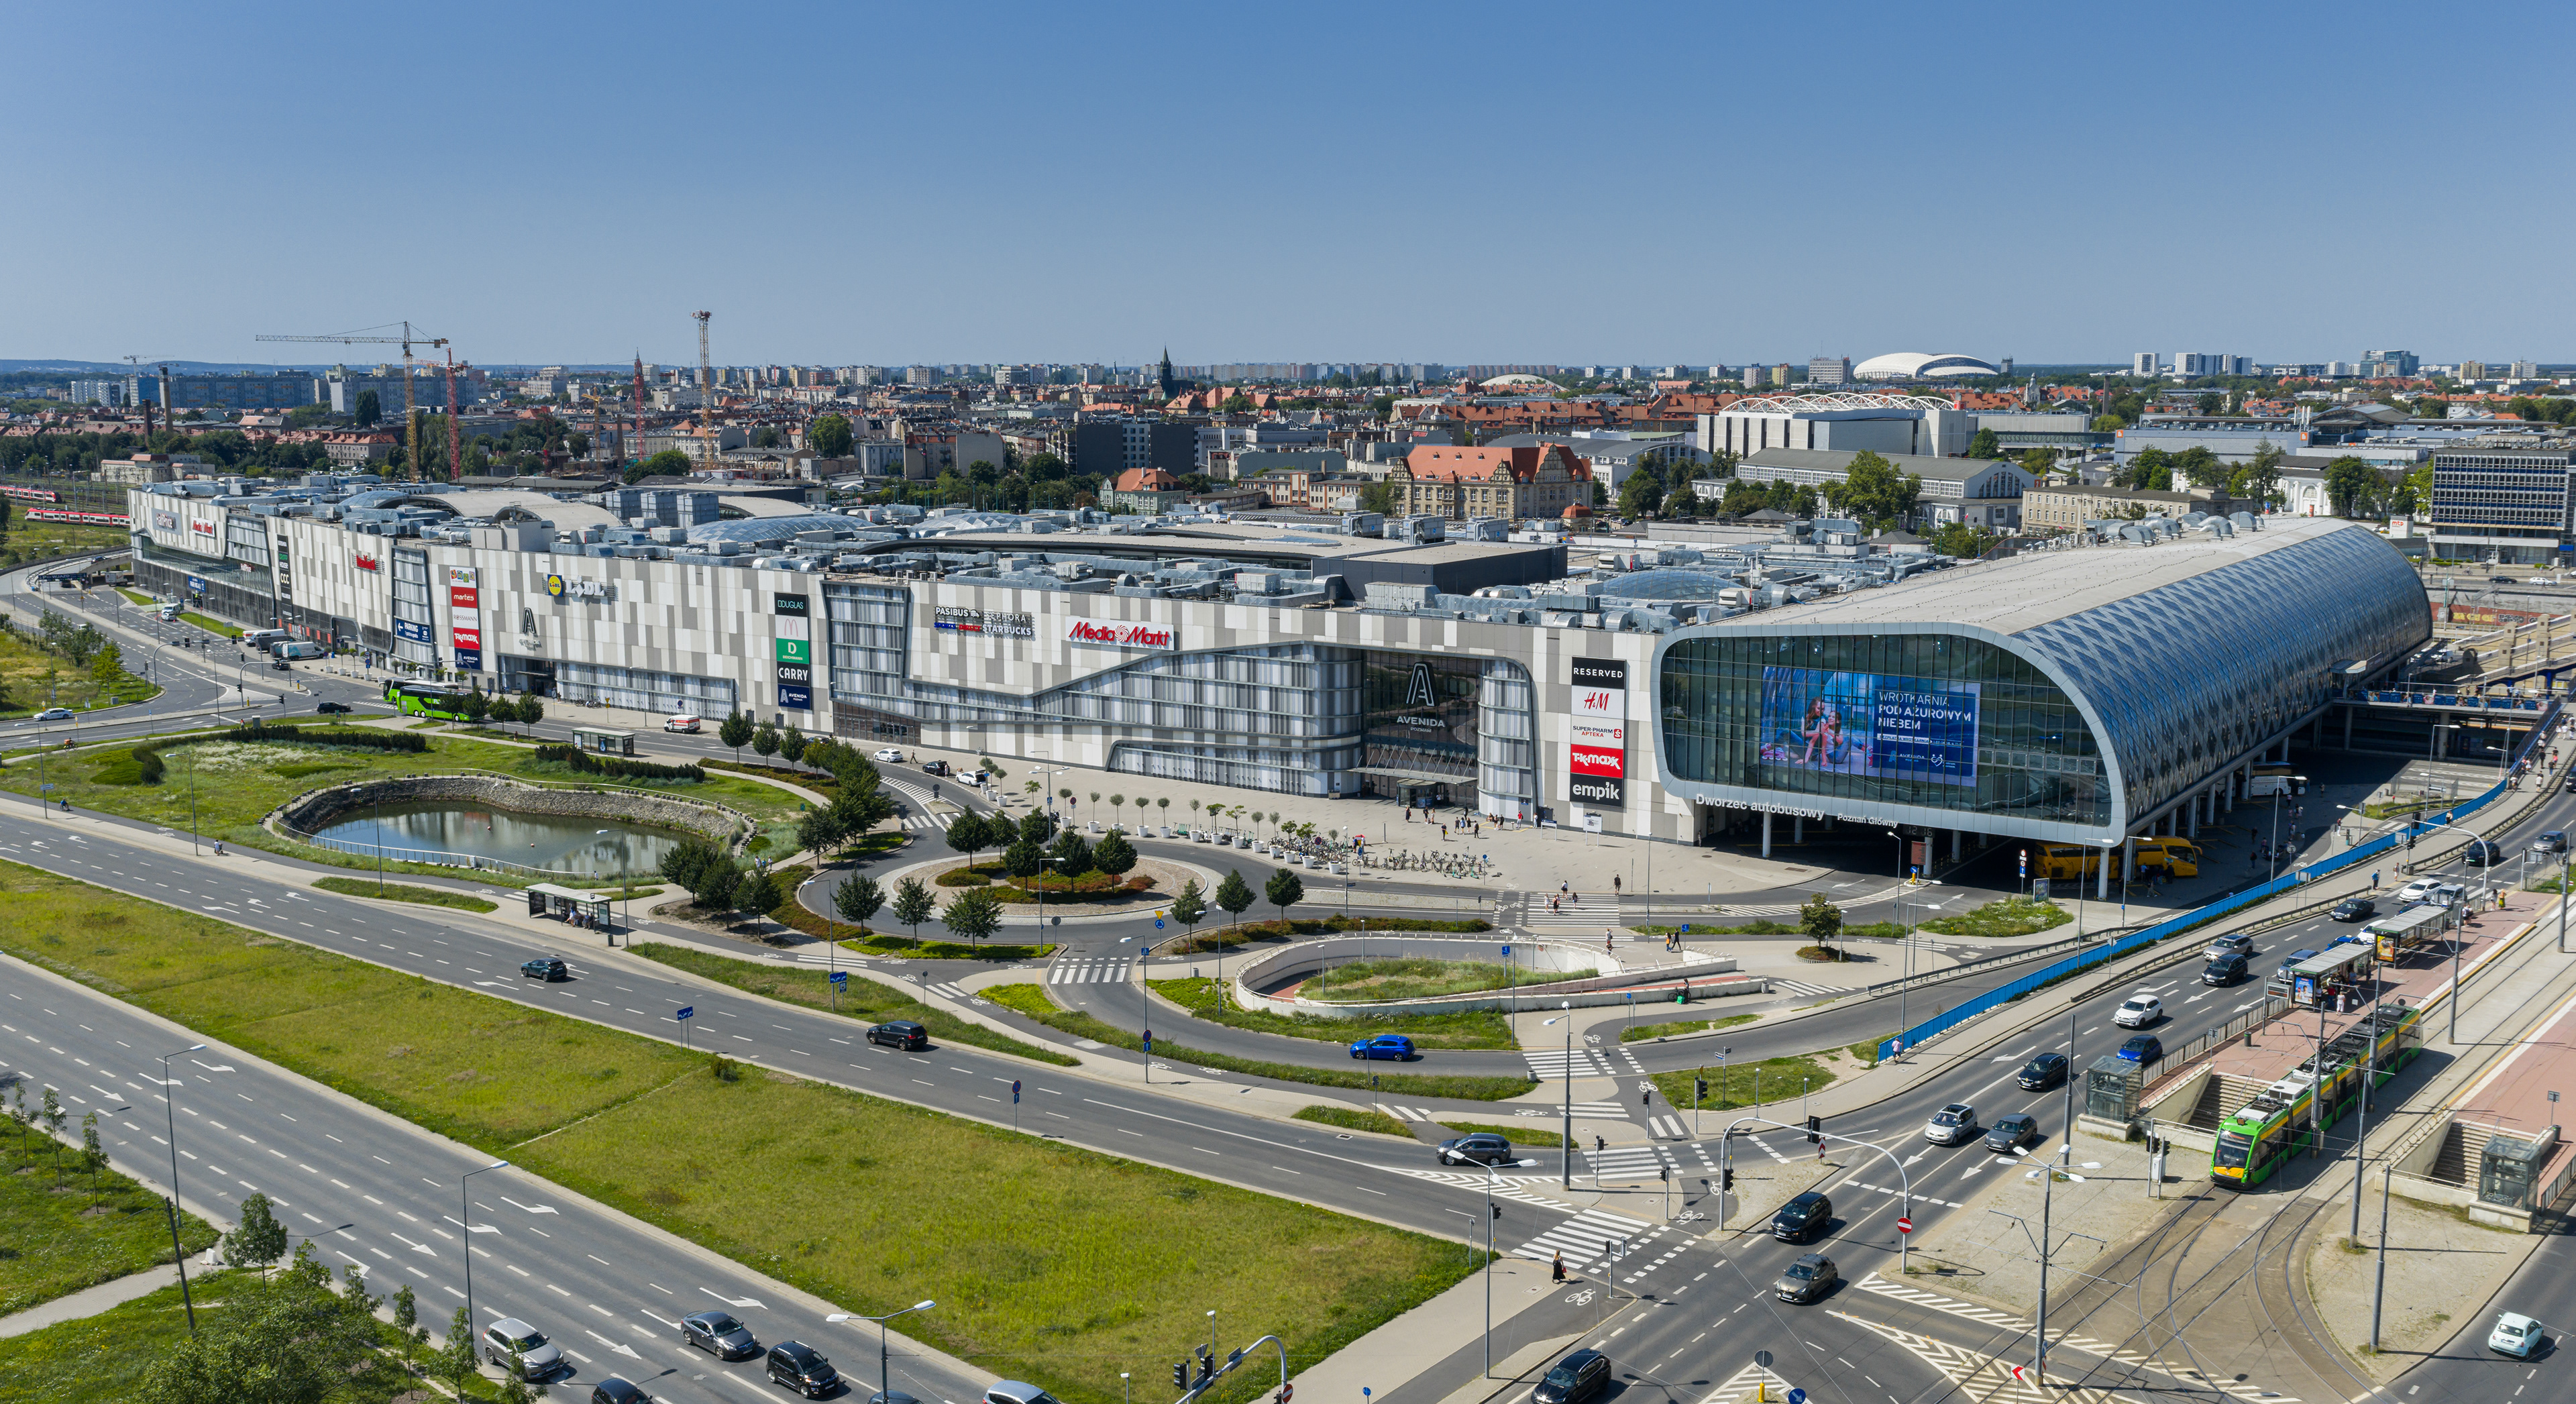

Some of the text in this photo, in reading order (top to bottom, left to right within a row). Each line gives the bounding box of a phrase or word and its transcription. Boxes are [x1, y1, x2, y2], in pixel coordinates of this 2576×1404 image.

[280, 573, 290, 584] CCC
[777, 600, 804, 610] DOUGLAS
[935, 606, 969, 617] PASIBUS
[985, 611, 1026, 623] SEPHORA
[453, 614, 478, 623] ROSSMANN
[404, 622, 419, 633] PARKING
[934, 622, 981, 632] SPORTS DIRECT
[982, 624, 1032, 636] STARBUCKS
[1068, 621, 1170, 646] Media Markt
[778, 667, 808, 682] CARRY
[1573, 667, 1623, 678] RESERVED
[1584, 692, 1610, 712] H&M
[1878, 691, 1950, 707] WROTKARNIA
[1878, 704, 1972, 722] POD AŻUROWYM
[1396, 715, 1446, 728] AVENIDA
[1878, 716, 1921, 731] NIEBEM
[1695, 793, 1825, 822] Dworzec autobusowy
[1837, 812, 1899, 829] Poznań Główny
